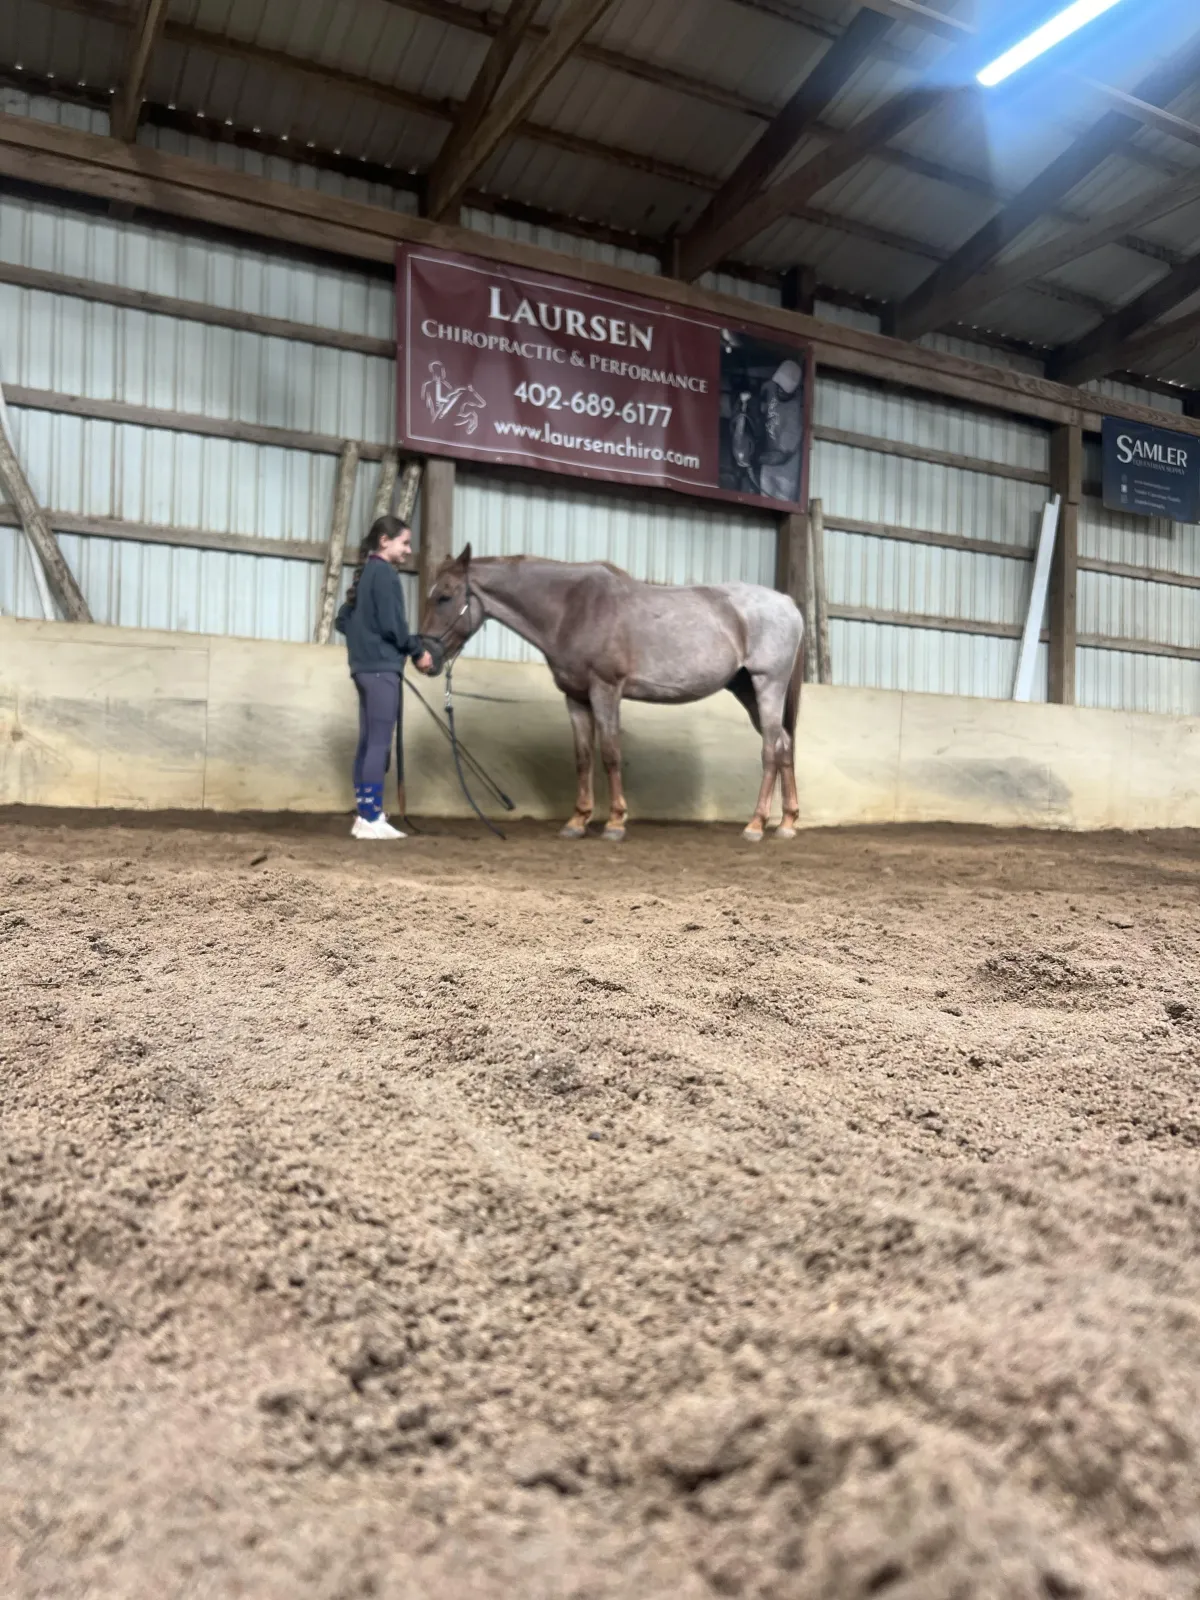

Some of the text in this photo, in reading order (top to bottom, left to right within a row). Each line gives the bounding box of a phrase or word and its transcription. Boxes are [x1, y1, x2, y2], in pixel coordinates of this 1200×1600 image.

[488, 286, 654, 352] LAURSEN
[421, 319, 709, 394] CHIROPRACTIC & PERFORMANCE
[513, 381, 673, 428] 402-689-6177
[493, 421, 700, 470] www.laursenchiro.com
[1116, 434, 1188, 468] SAMLER
